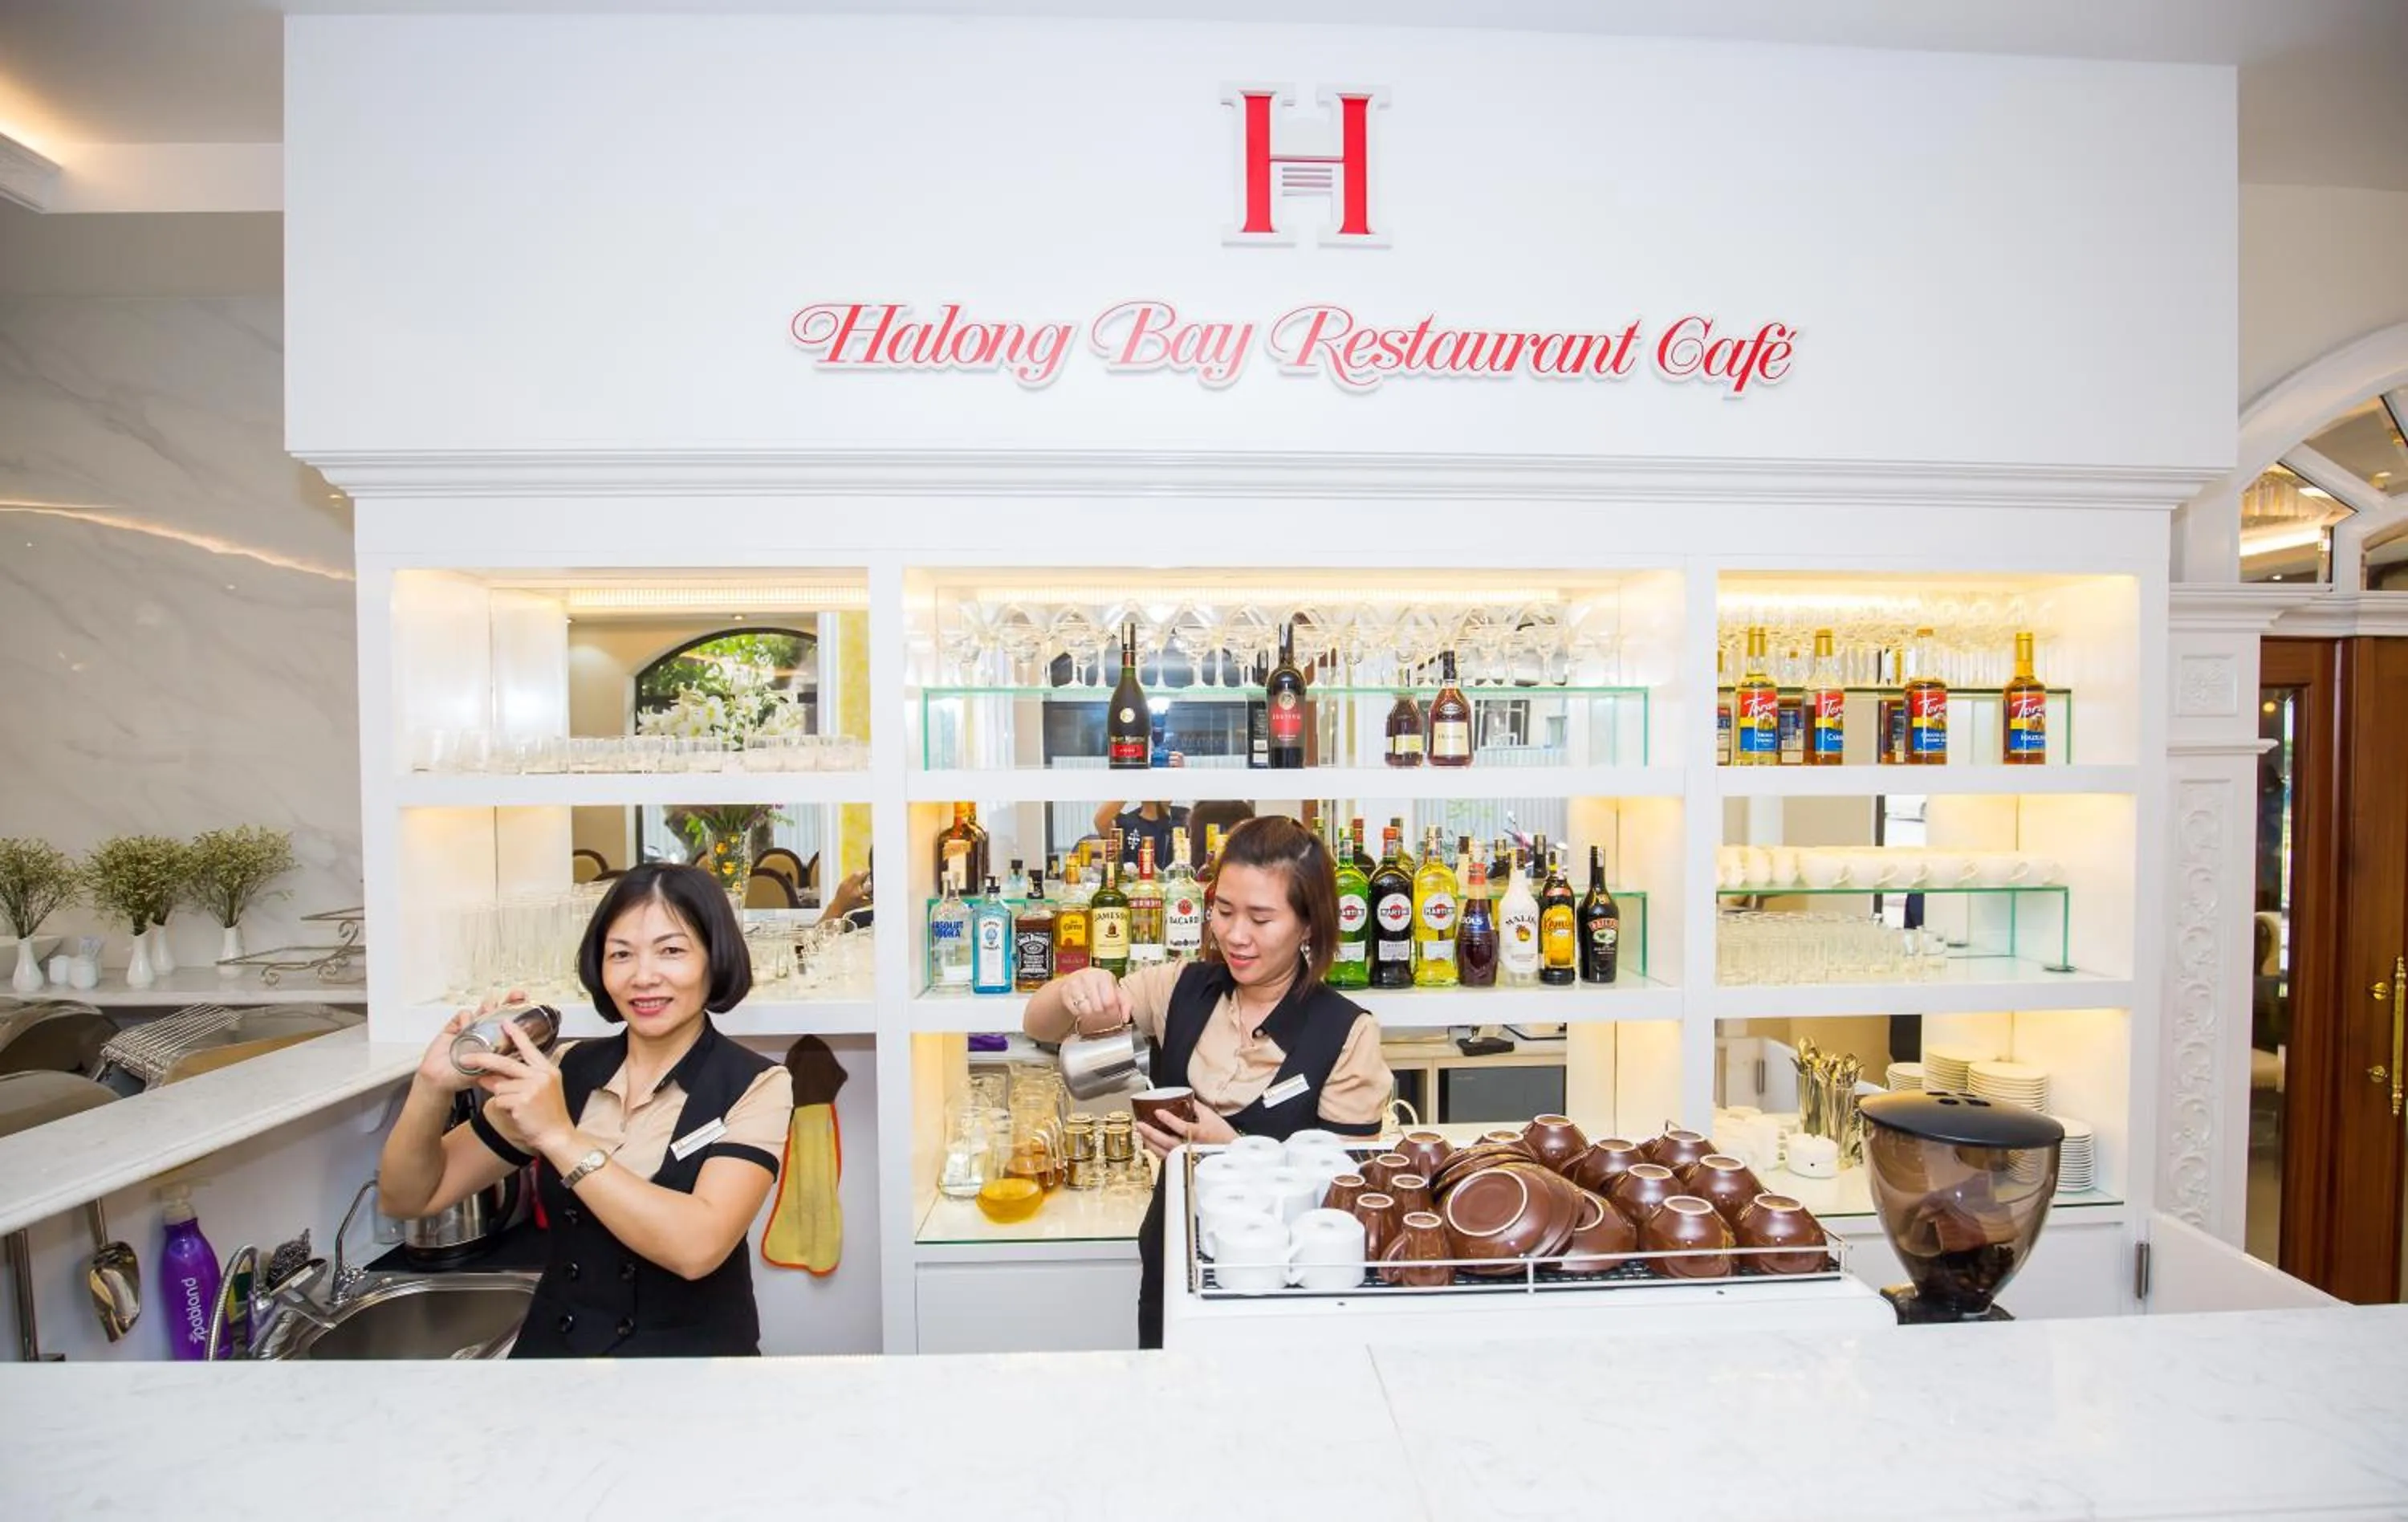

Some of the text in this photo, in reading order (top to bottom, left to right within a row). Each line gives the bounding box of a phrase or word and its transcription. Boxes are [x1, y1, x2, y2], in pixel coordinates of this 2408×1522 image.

[1228, 86, 1384, 242] H
[791, 299, 1797, 394] Halong Bay Restaurant Café
[1169, 916, 1199, 925] BACARD
